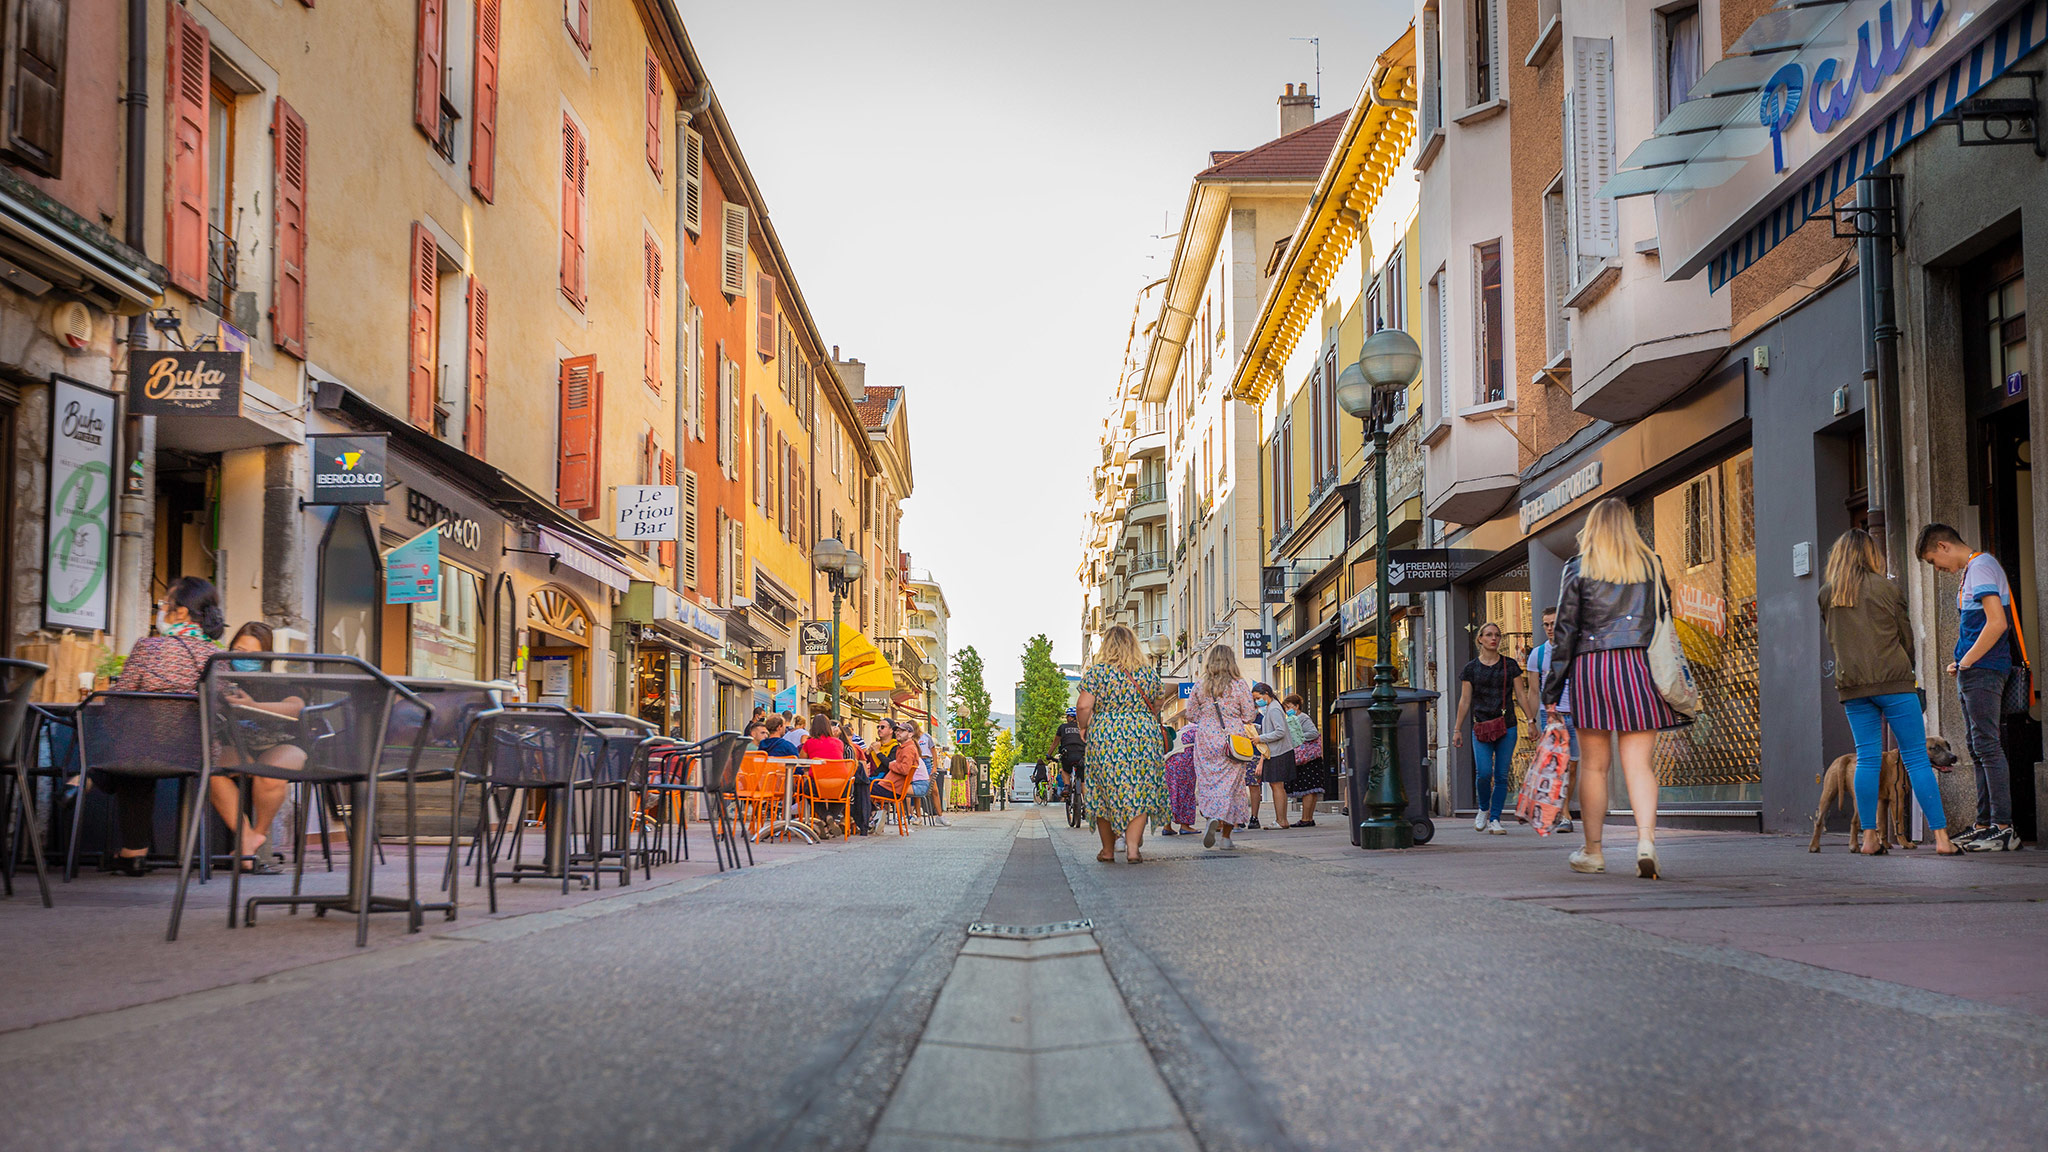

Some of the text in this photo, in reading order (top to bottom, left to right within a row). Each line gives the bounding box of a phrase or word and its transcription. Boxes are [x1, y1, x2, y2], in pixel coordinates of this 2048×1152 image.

[144, 357, 226, 399] Bufa
[61, 401, 105, 437] Bufa
[316, 473, 383, 484] IBERICO & CO
[638, 490, 662, 503] Le
[620, 504, 674, 523] P'tiou
[633, 522, 666, 536] Bar
[1405, 562, 1447, 571] FREEMAN
[1406, 570, 1448, 579] T.PORTER
[805, 644, 828, 652] COFFEE
[1244, 640, 1262, 648] CAD
